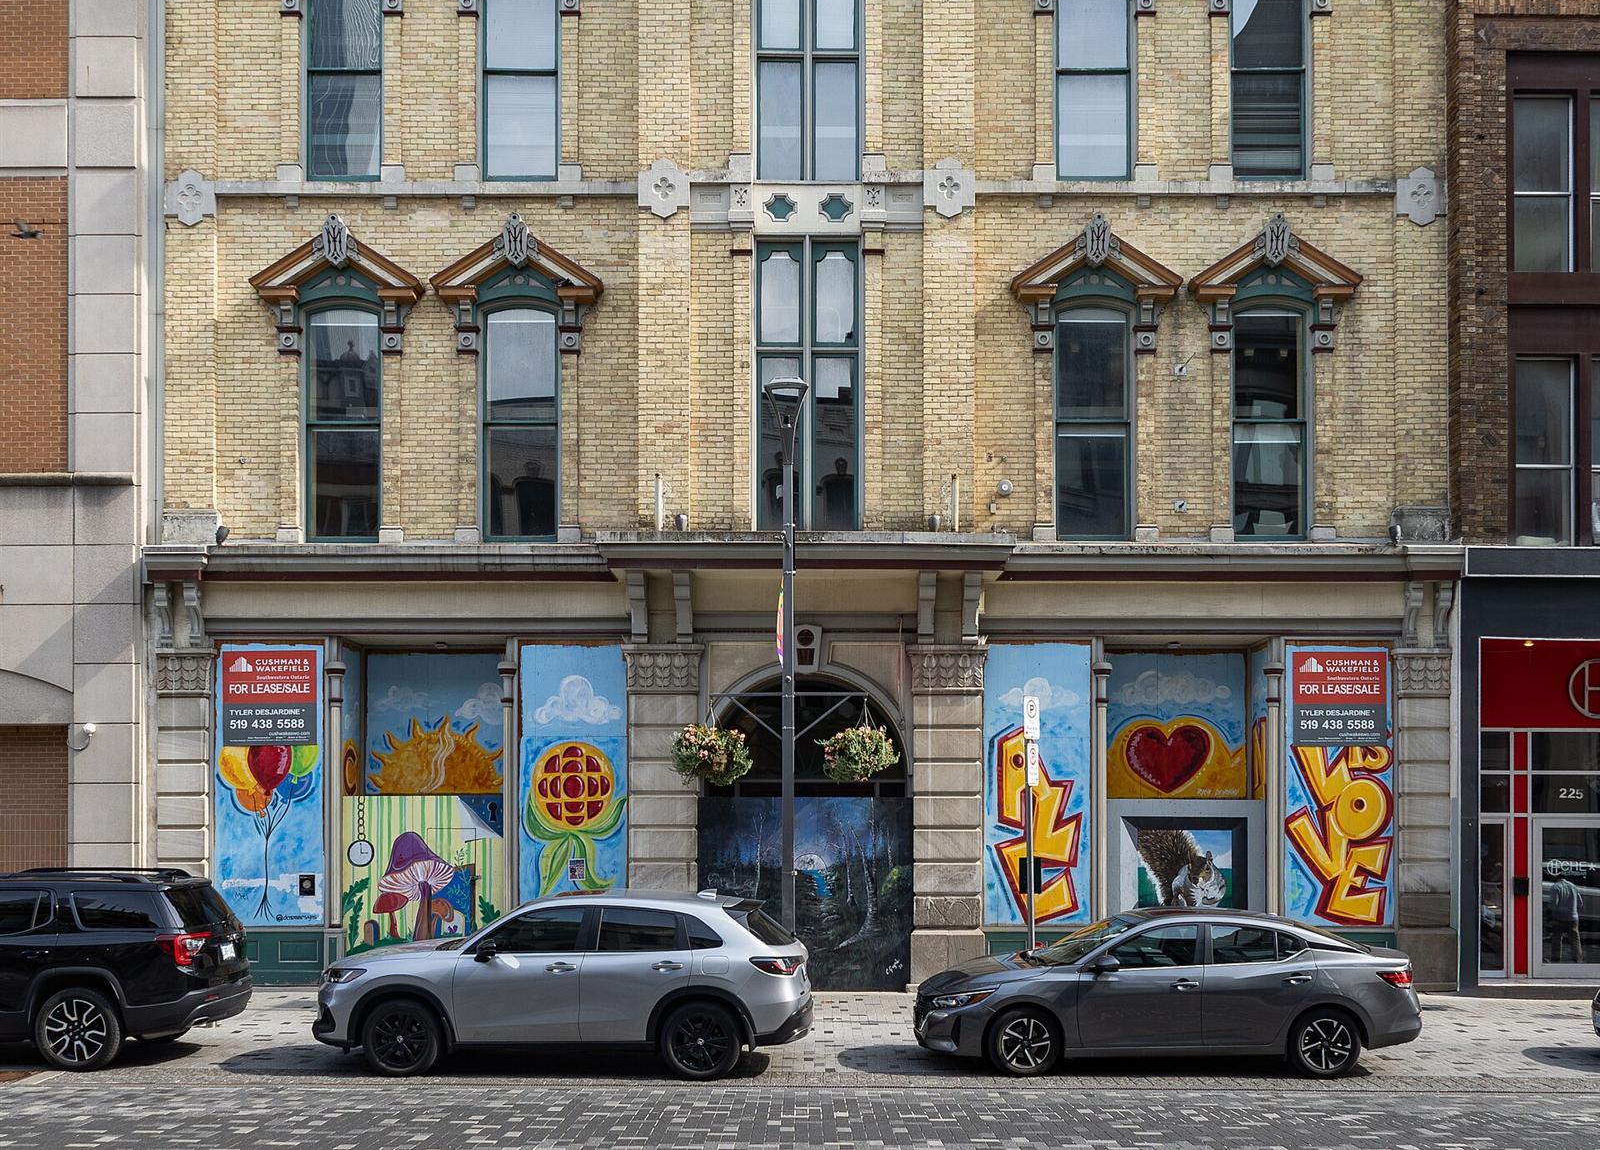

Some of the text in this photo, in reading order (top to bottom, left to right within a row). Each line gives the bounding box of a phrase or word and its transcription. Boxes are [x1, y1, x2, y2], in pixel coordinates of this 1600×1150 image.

[229, 683, 310, 694] FOR LEASE/SALE
[1299, 684, 1380, 695] FOR LEASE/SALE
[229, 718, 305, 729] 519 438 5588
[1300, 719, 1375, 730] 519 438 5588
[1559, 787, 1584, 800] 225
[1285, 745, 1393, 926] LOVE
